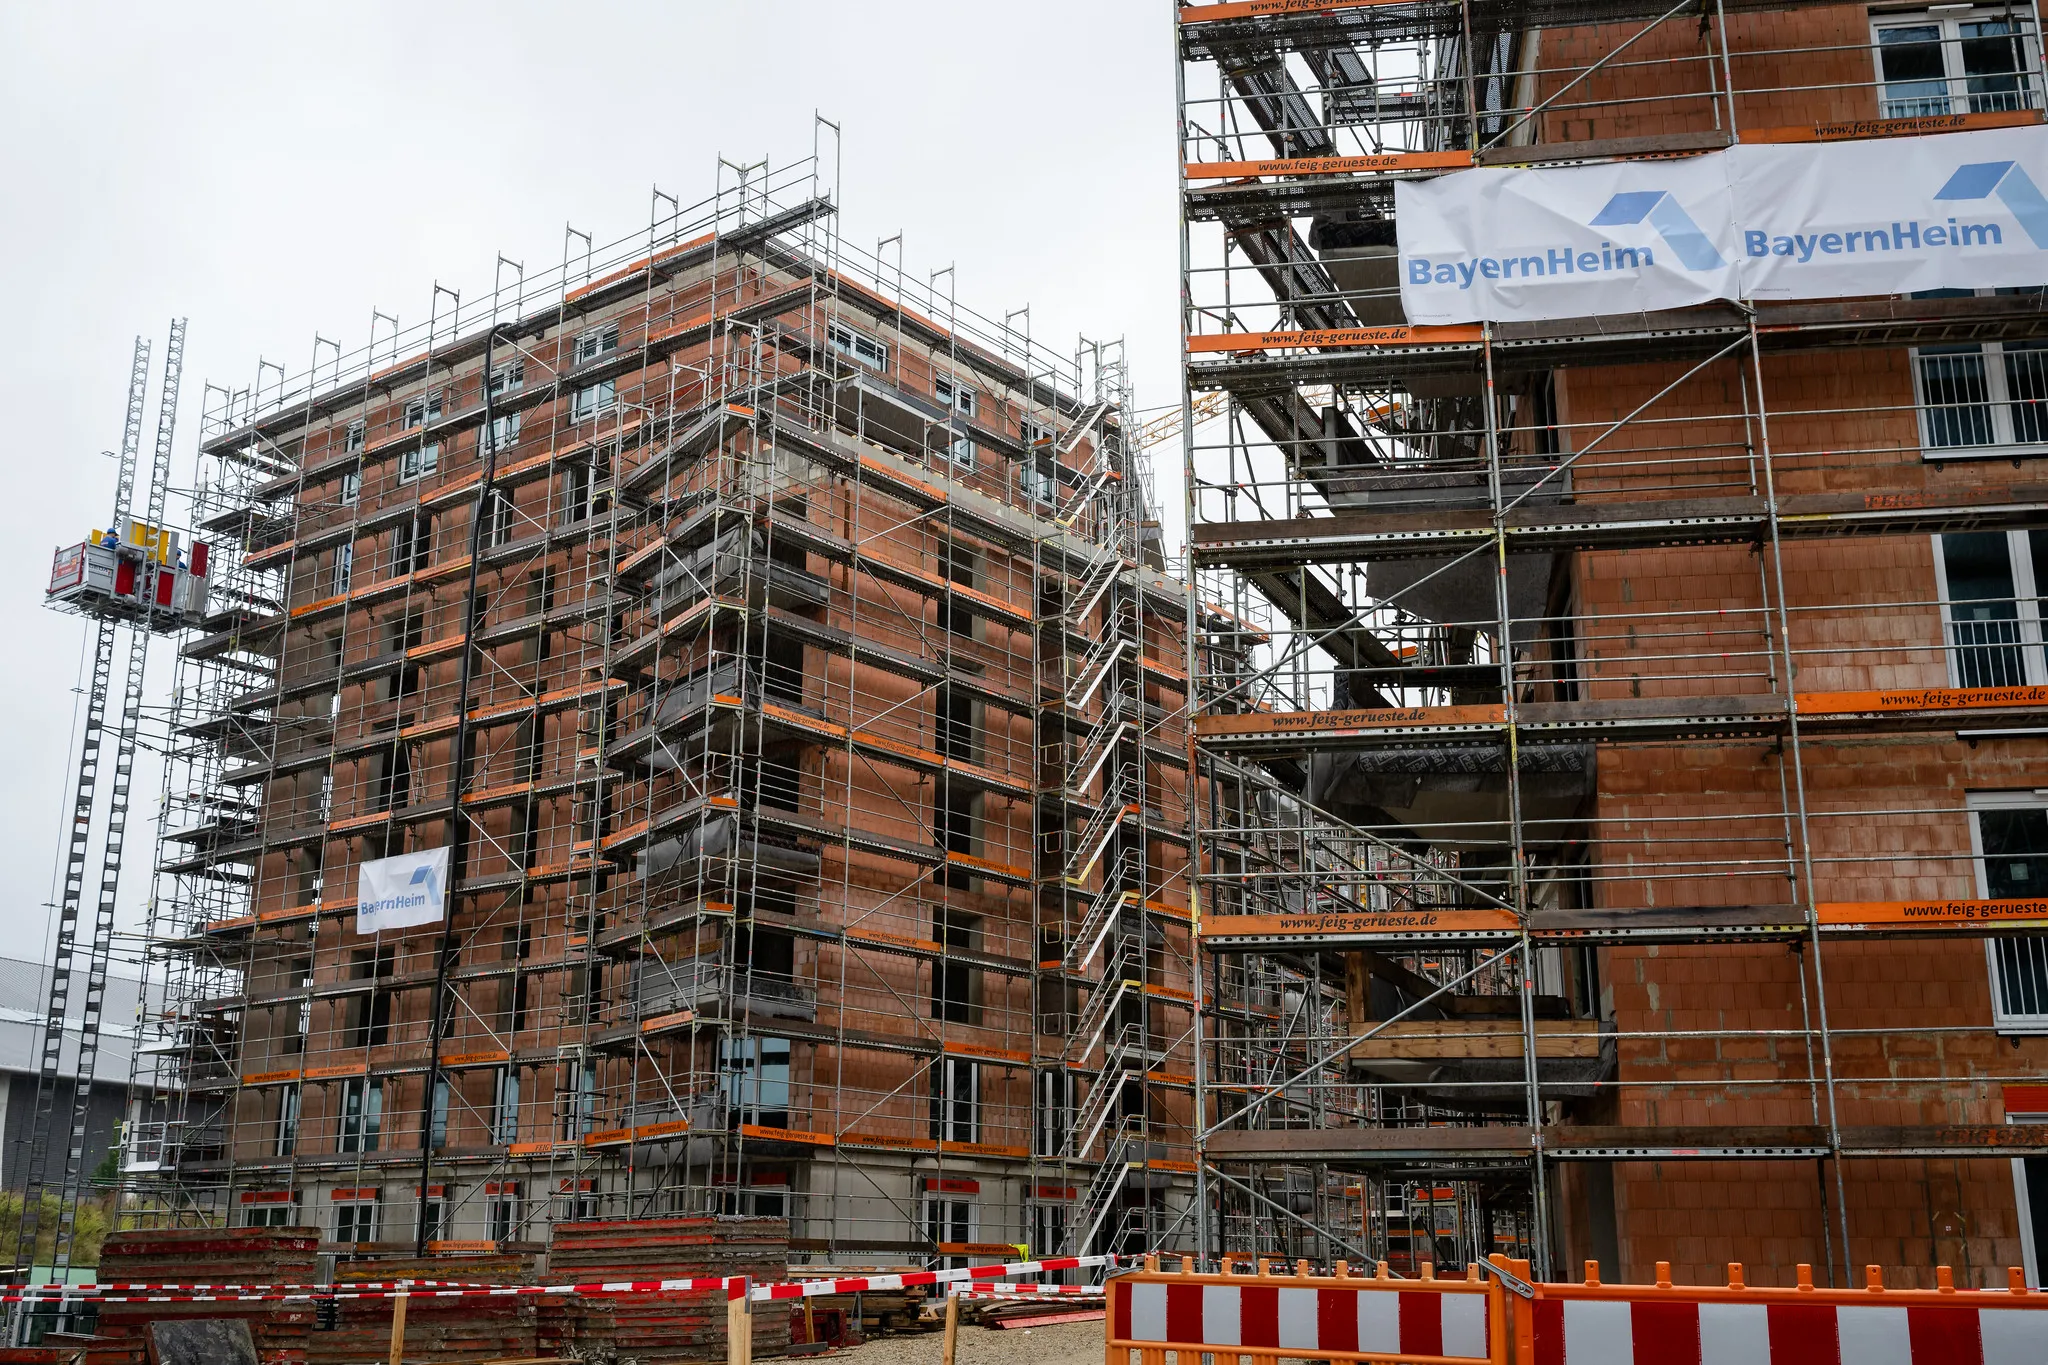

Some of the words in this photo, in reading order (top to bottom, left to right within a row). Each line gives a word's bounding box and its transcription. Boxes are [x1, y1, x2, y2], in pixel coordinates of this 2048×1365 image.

[1814, 117, 1966, 136] www.feig-gerueste.de
[1258, 155, 1398, 172] www.feig-gerueste.de
[1744, 218, 2002, 263] BayernHeim
[1408, 242, 1654, 290] BayernHeim
[1261, 329, 1407, 345] www.feig-gerueste.de
[1880, 685, 2045, 707] www.feig-gerueste.de
[1272, 709, 1426, 727] www.feig-gerueste.de
[1279, 913, 1437, 931] www.feig-gerueste.de
[759, 1128, 816, 1140] www.feig-gerueste.de
